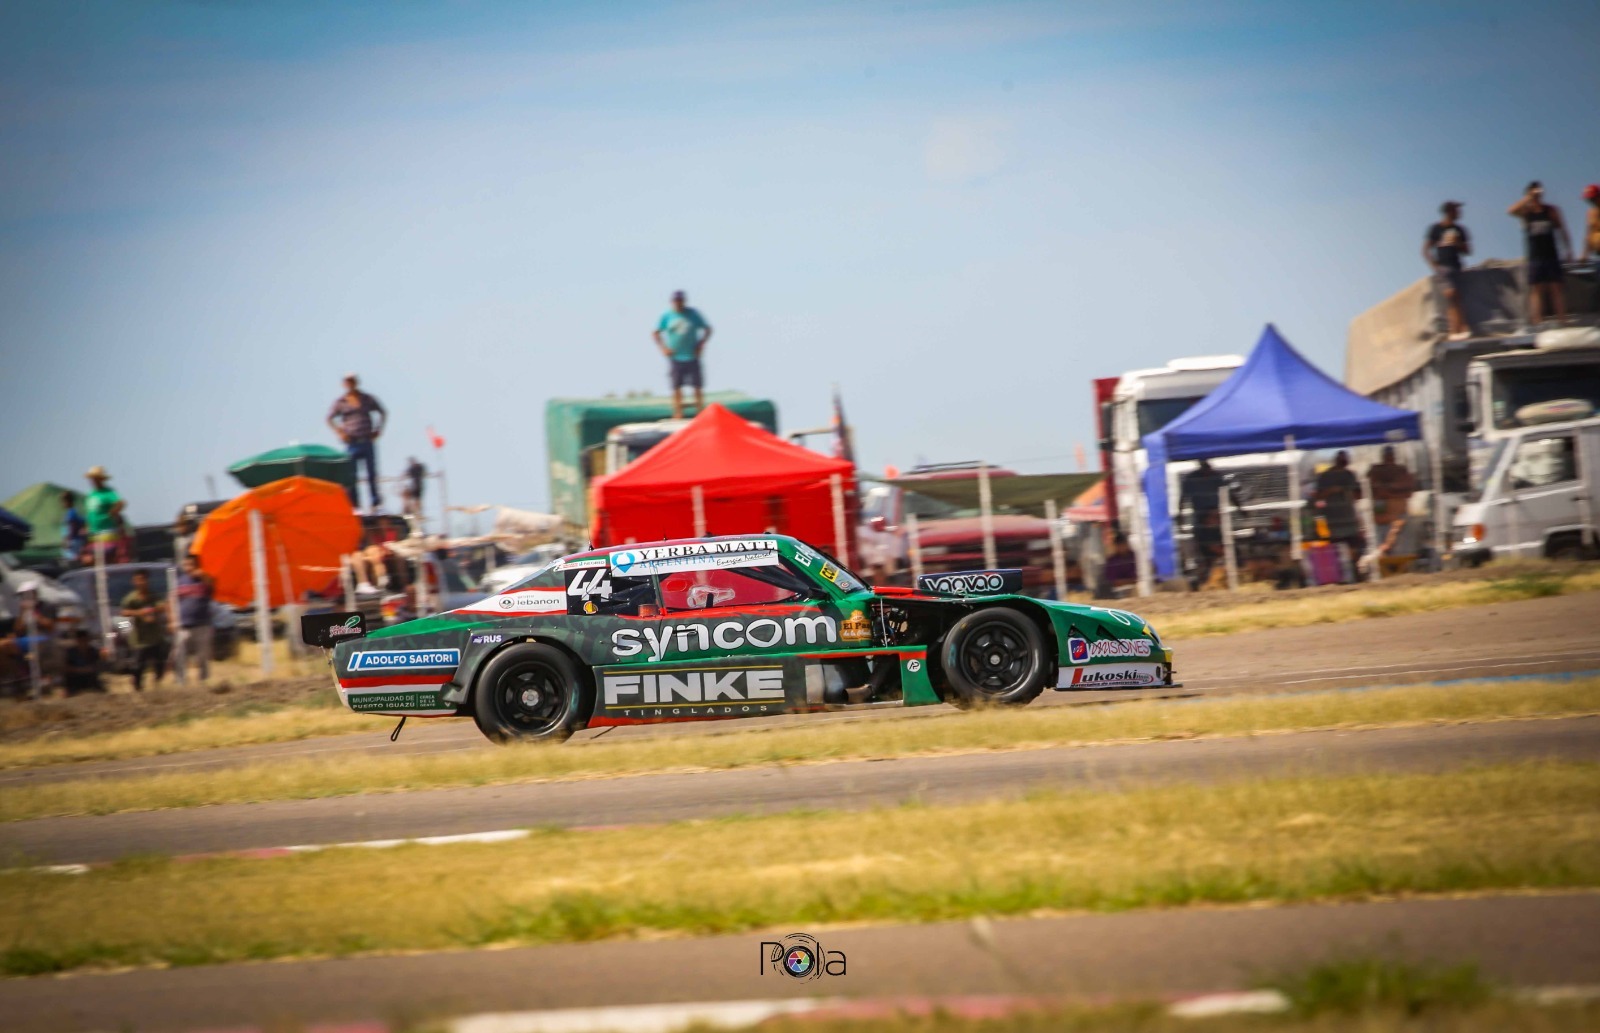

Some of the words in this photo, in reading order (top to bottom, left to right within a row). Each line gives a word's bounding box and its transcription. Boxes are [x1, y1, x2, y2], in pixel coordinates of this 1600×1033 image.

[639, 543, 705, 560] YERBA
[715, 541, 775, 554] MATE
[639, 555, 716, 569] ARGENTINA
[567, 569, 612, 602] 44
[517, 598, 560, 606] lebanon
[483, 635, 502, 644] RUS
[611, 615, 837, 662] syncom
[365, 654, 407, 665] ADOLFO
[409, 653, 453, 664] SARTORI
[603, 669, 786, 705] FINKE
[352, 695, 404, 704] MUNICIPALIDAD
[624, 705, 768, 716] TINGLADOS
